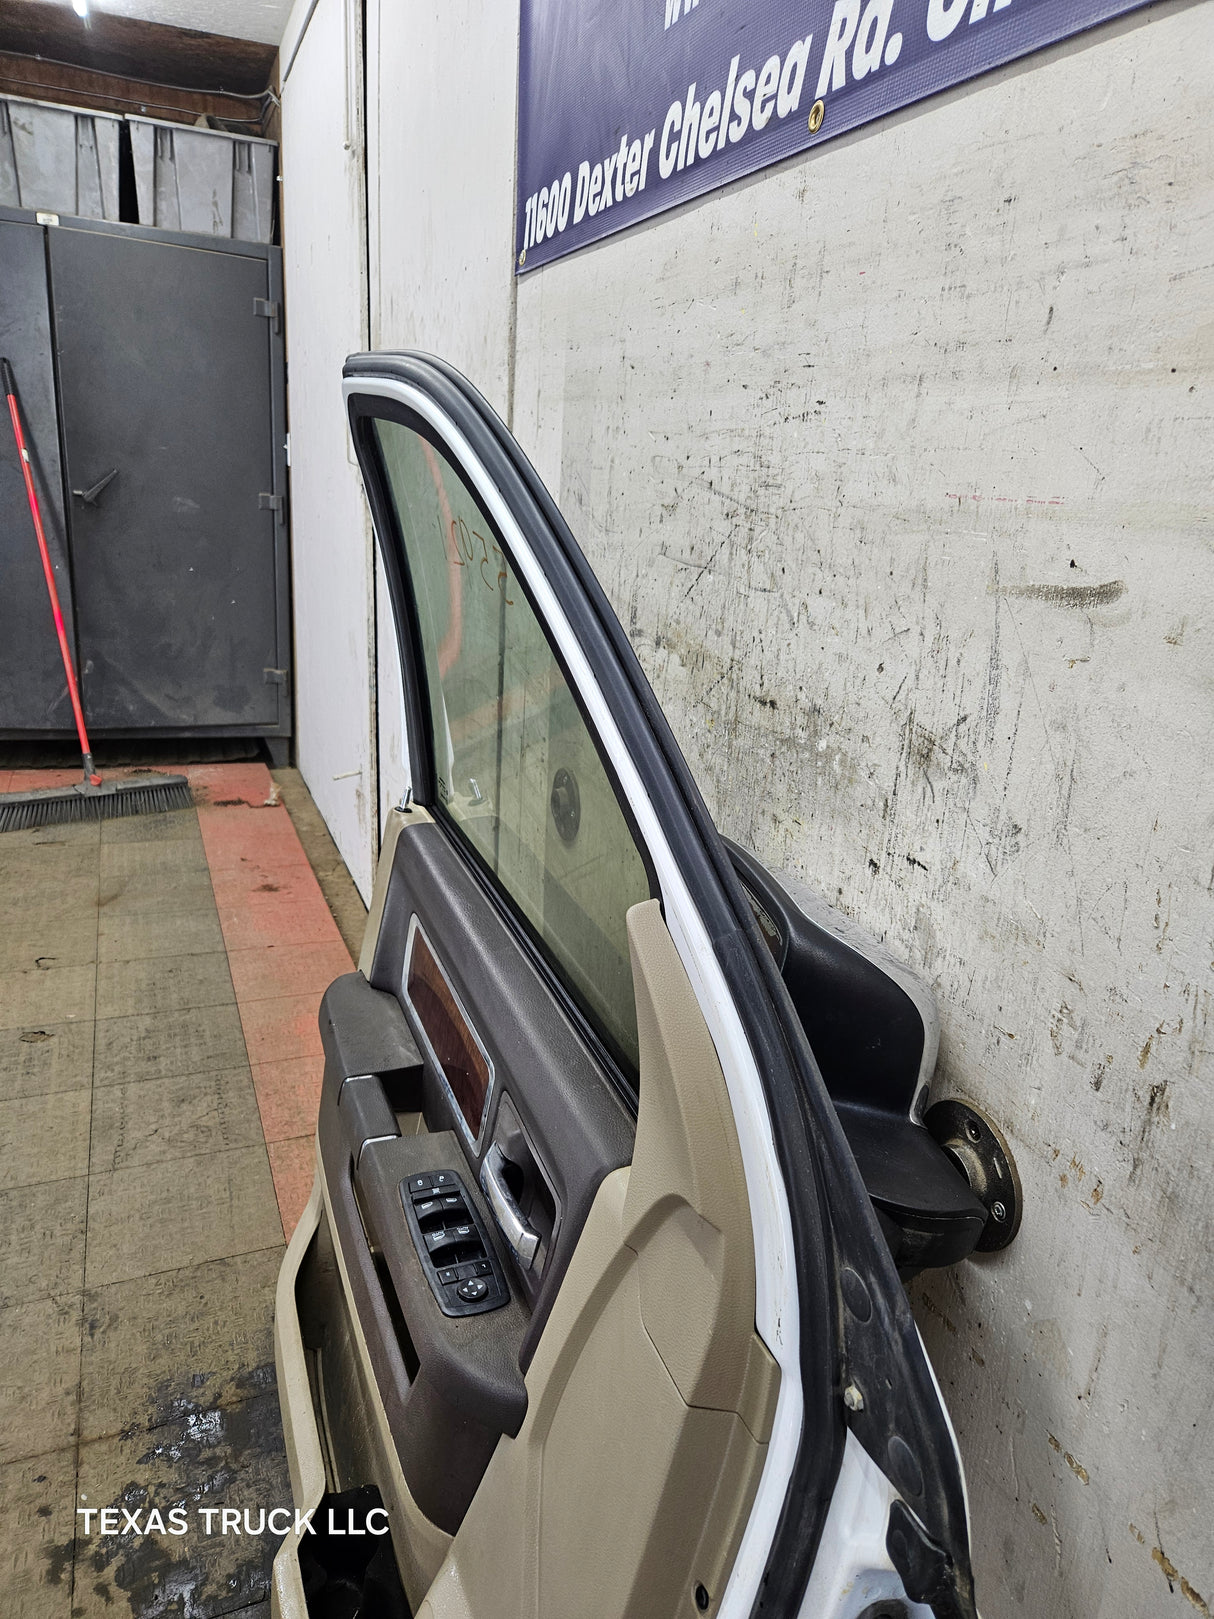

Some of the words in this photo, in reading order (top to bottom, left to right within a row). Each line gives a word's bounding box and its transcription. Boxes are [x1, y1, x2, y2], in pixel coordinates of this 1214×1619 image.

[523, 172, 571, 249] 11600
[573, 128, 655, 225] Dexter
[659, 34, 812, 179] Chelsea
[815, 0, 903, 100] Rd.
